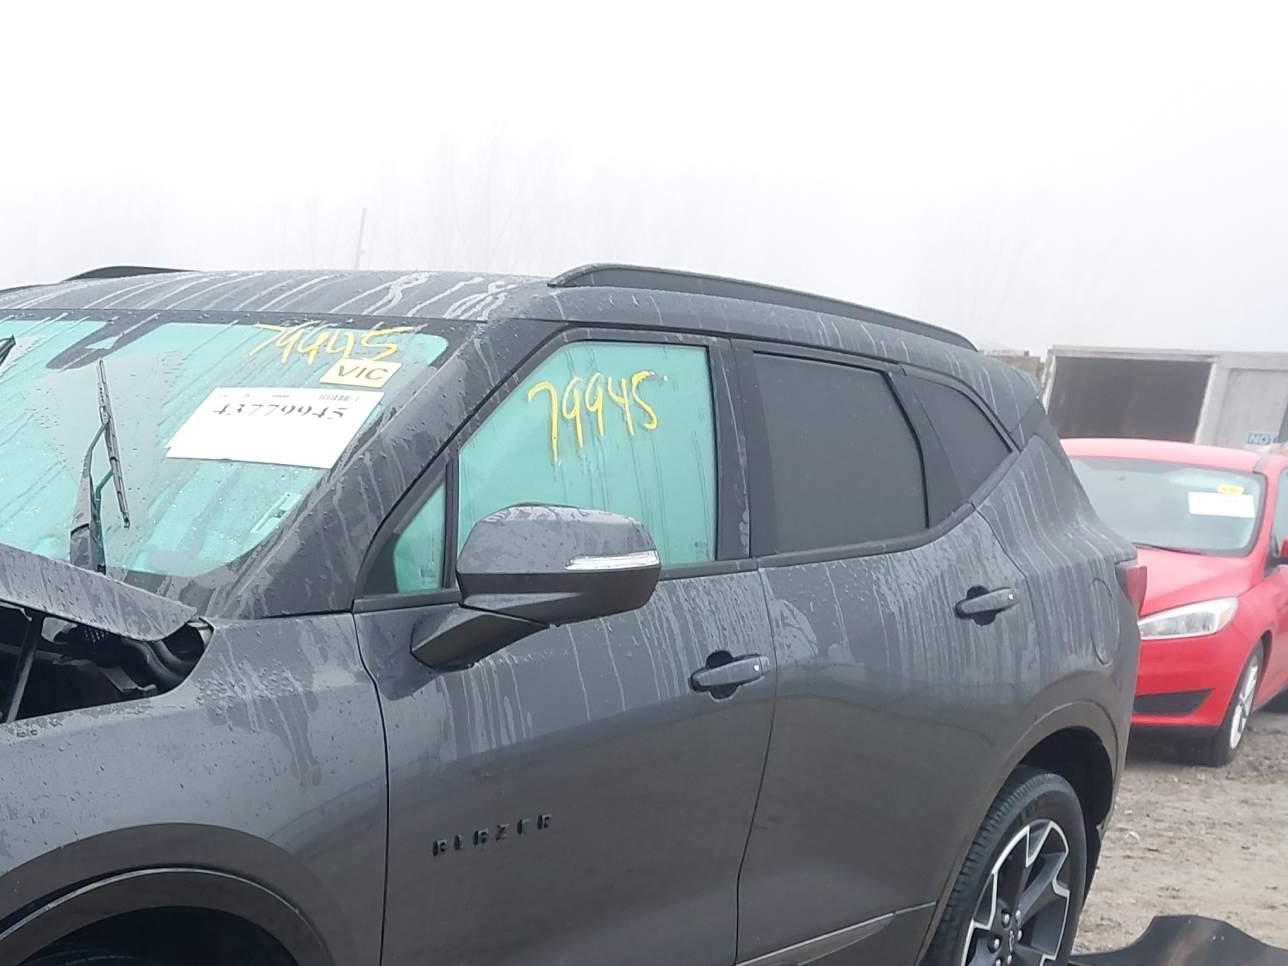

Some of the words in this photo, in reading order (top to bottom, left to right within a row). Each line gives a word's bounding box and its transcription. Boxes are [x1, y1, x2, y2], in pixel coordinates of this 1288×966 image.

[249, 320, 424, 365] 79945
[337, 366, 389, 382] VIC
[212, 403, 349, 421] 43779945
[526, 370, 659, 464] 79945
